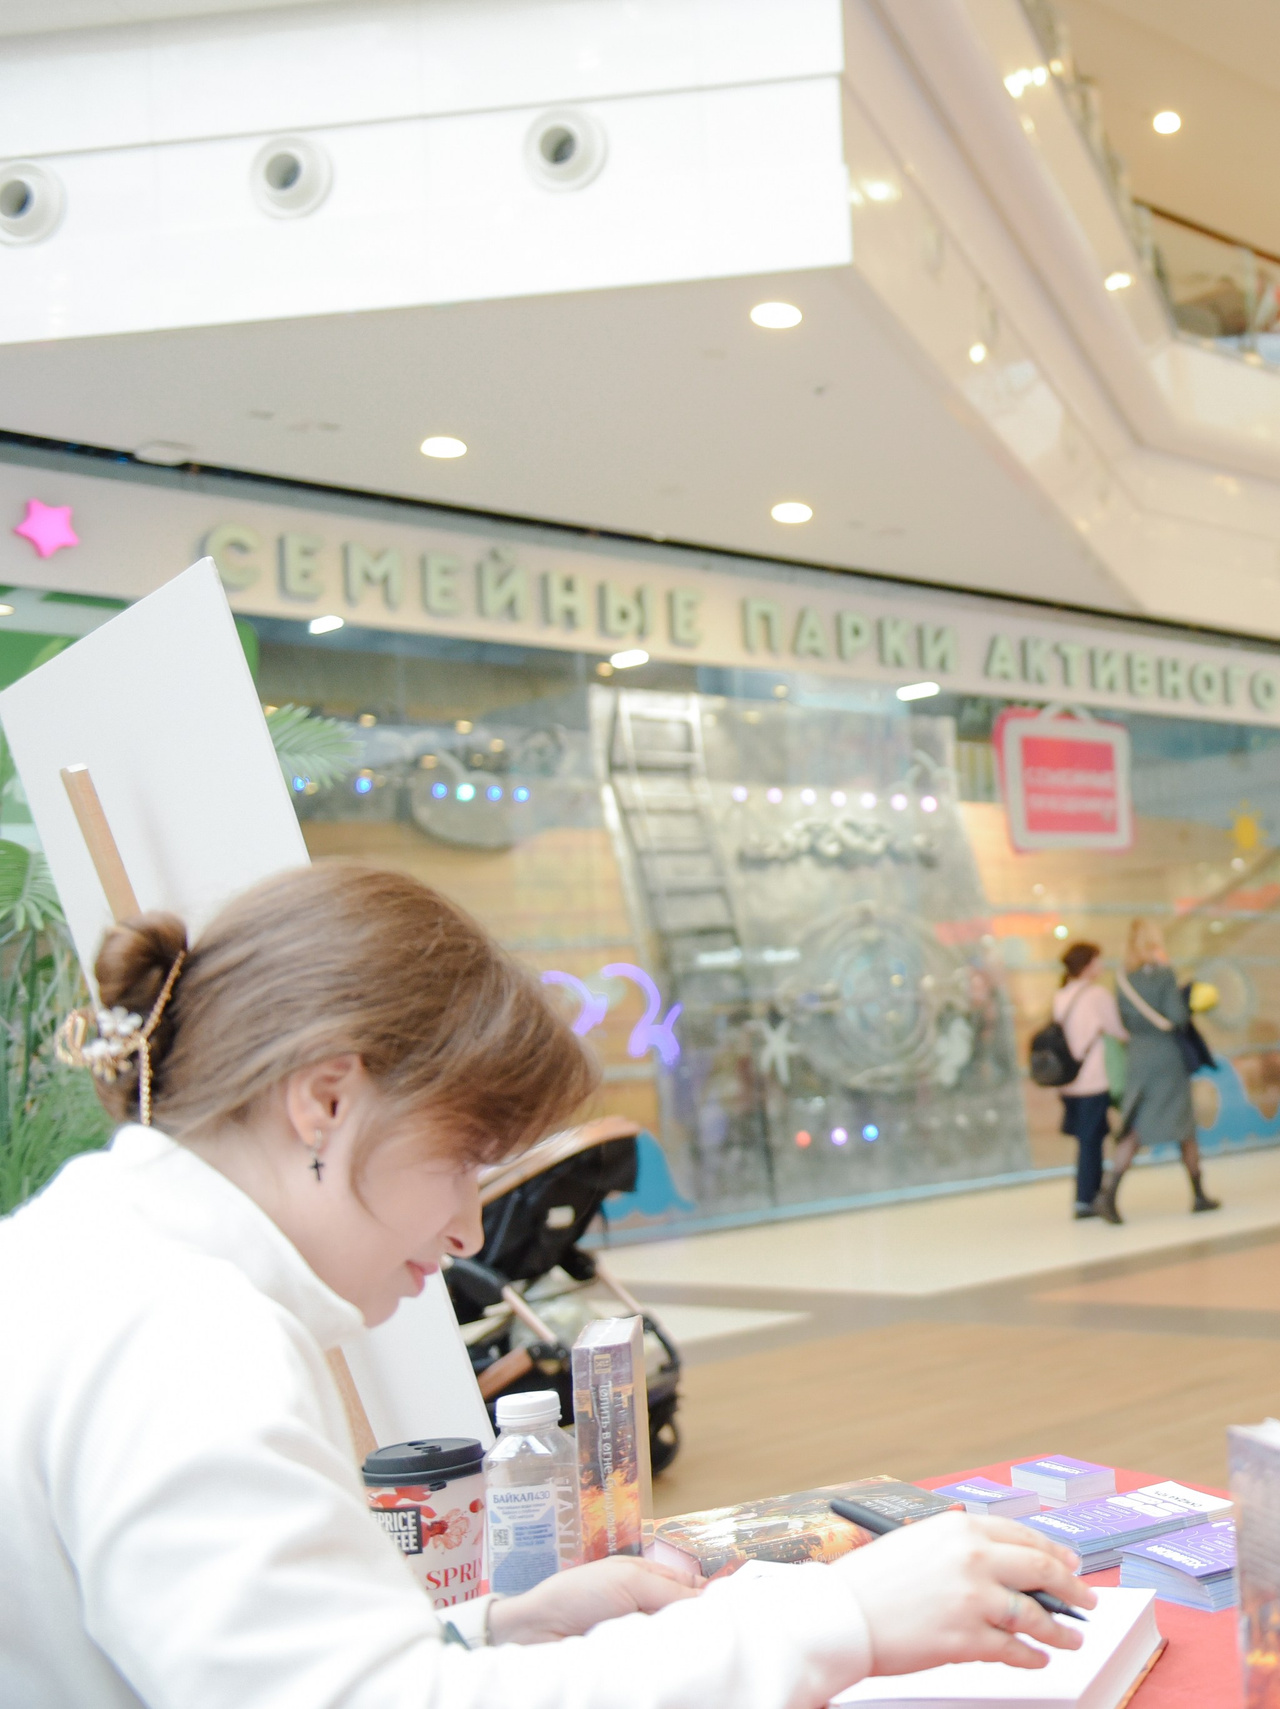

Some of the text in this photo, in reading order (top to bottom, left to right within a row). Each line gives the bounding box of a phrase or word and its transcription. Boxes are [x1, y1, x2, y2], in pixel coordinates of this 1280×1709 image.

[203, 523, 701, 648] СЕМЕЙНЫЕ
[743, 597, 958, 675] ПАРКИ
[984, 634, 1277, 711] АКТИВНОГО
[377, 1511, 417, 1532] PRICE
